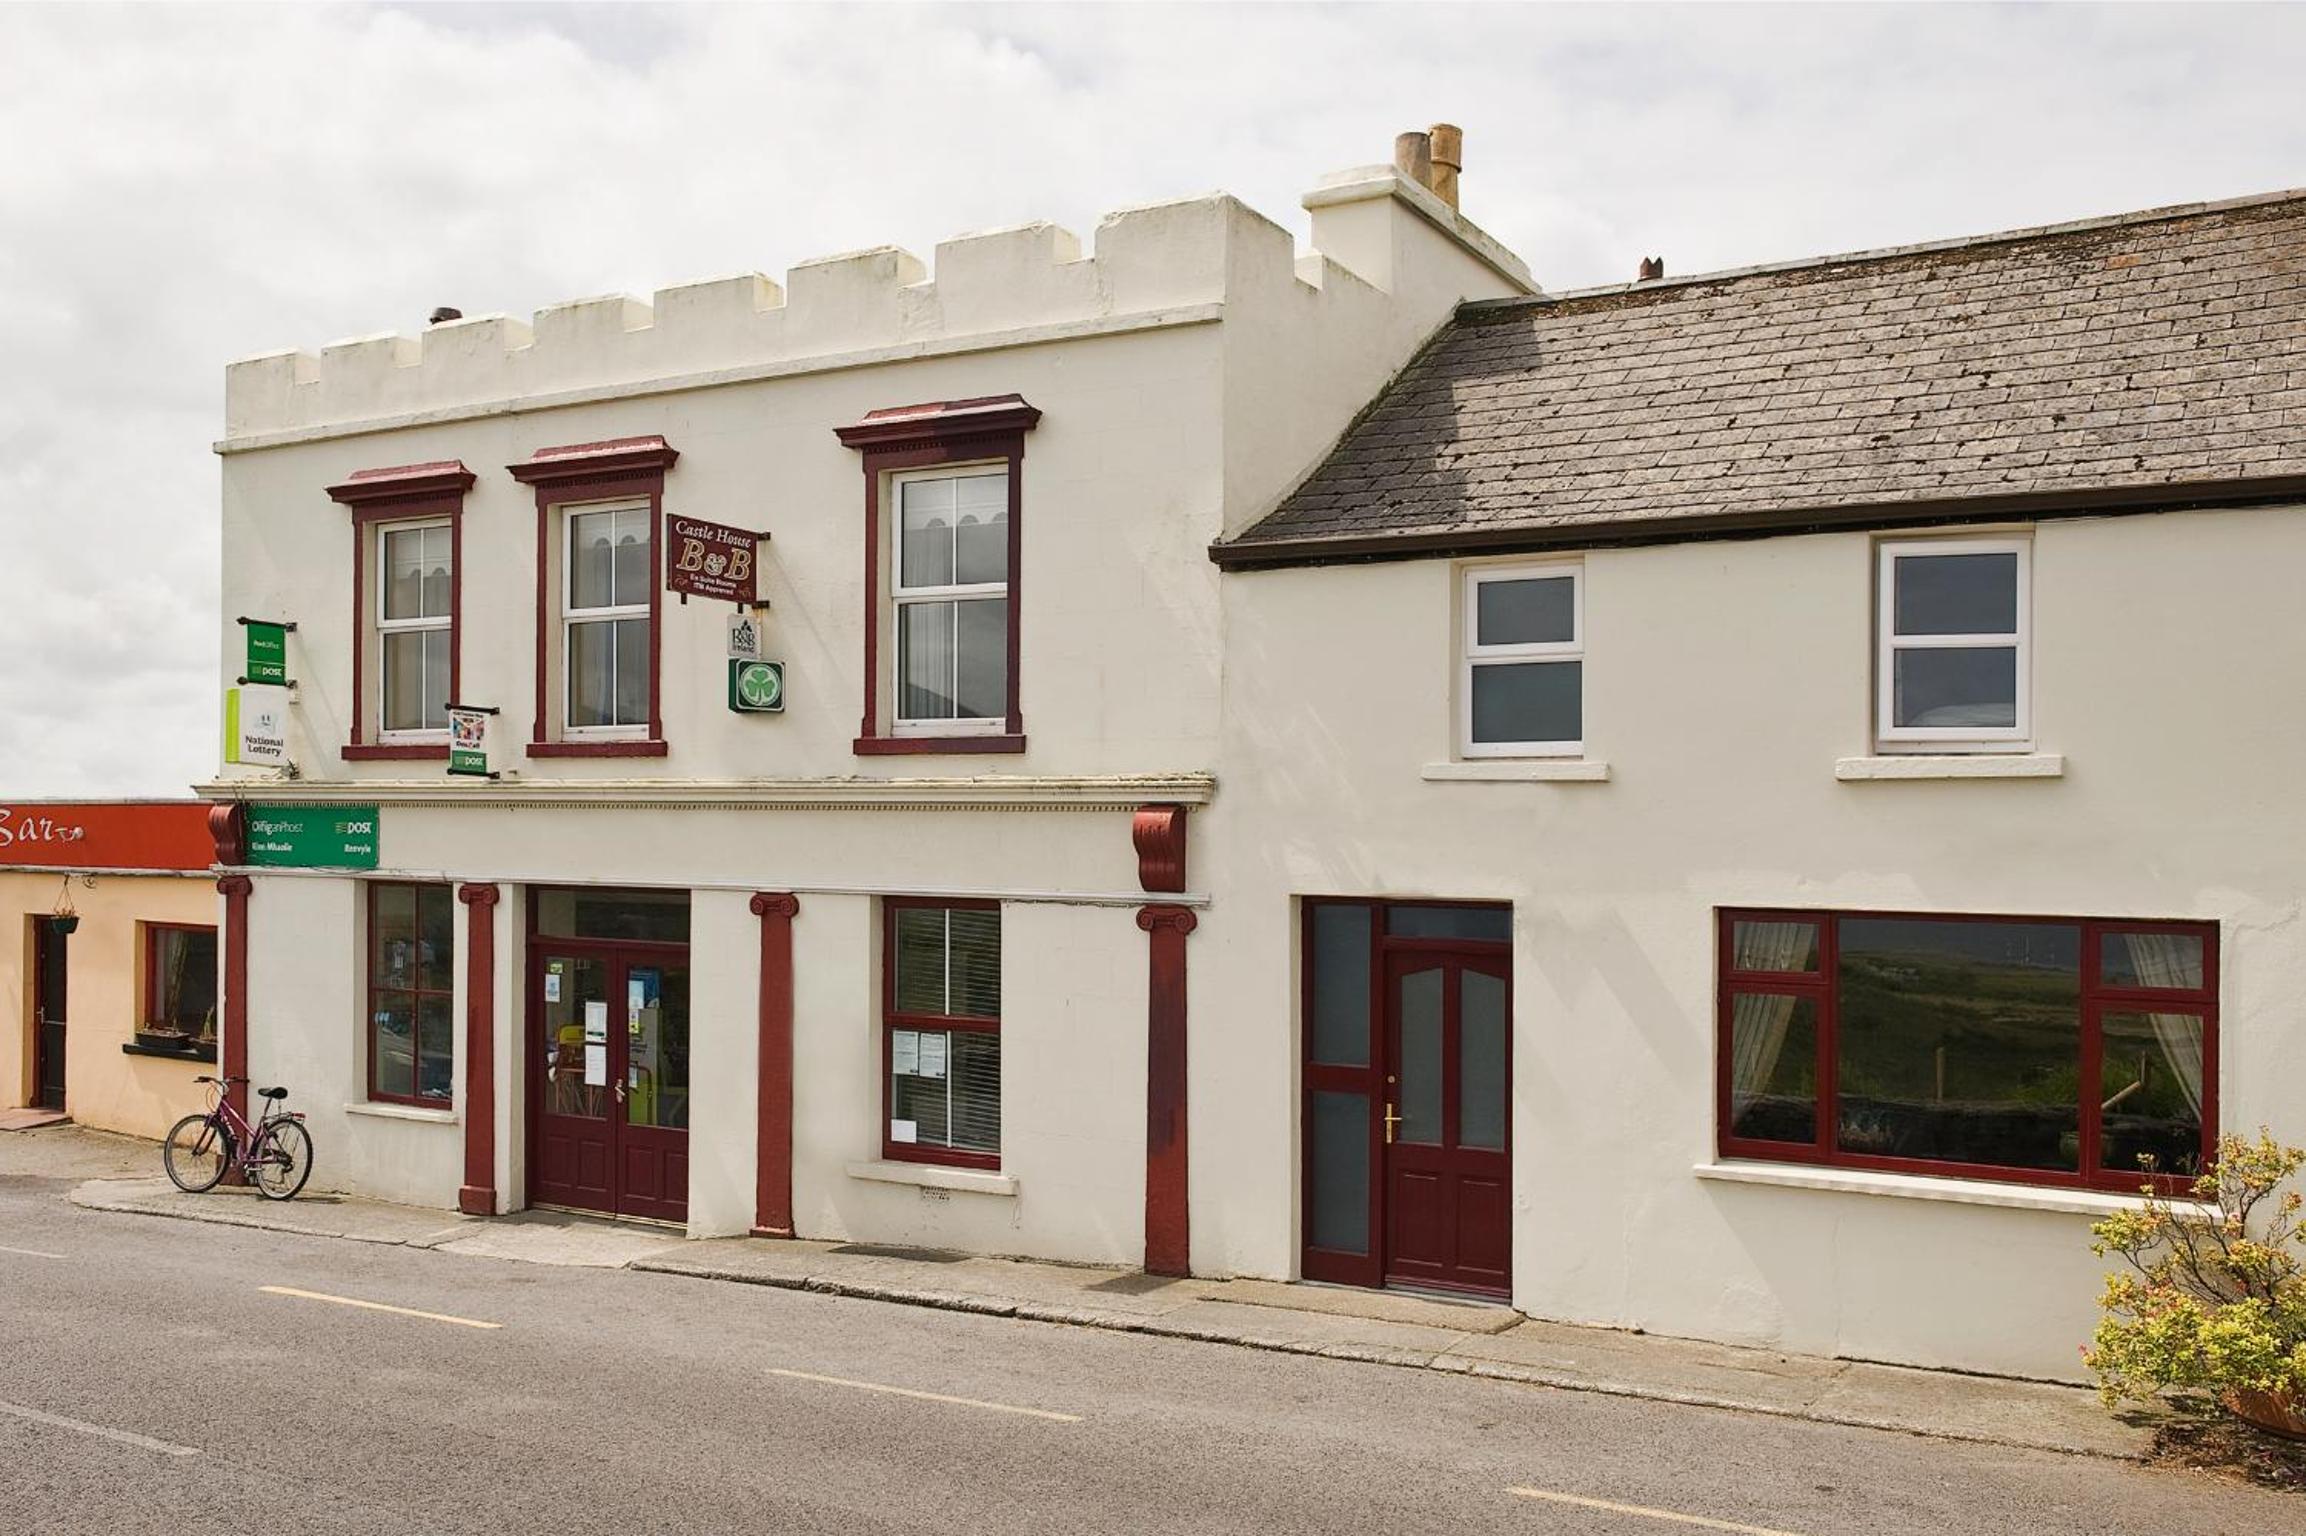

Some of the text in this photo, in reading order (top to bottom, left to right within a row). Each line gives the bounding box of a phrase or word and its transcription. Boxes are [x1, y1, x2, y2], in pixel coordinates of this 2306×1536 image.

[675, 520, 751, 548] Castle House
[245, 735, 284, 748] National
[248, 744, 282, 757] Lottery
[344, 844, 371, 855] Renvyle
